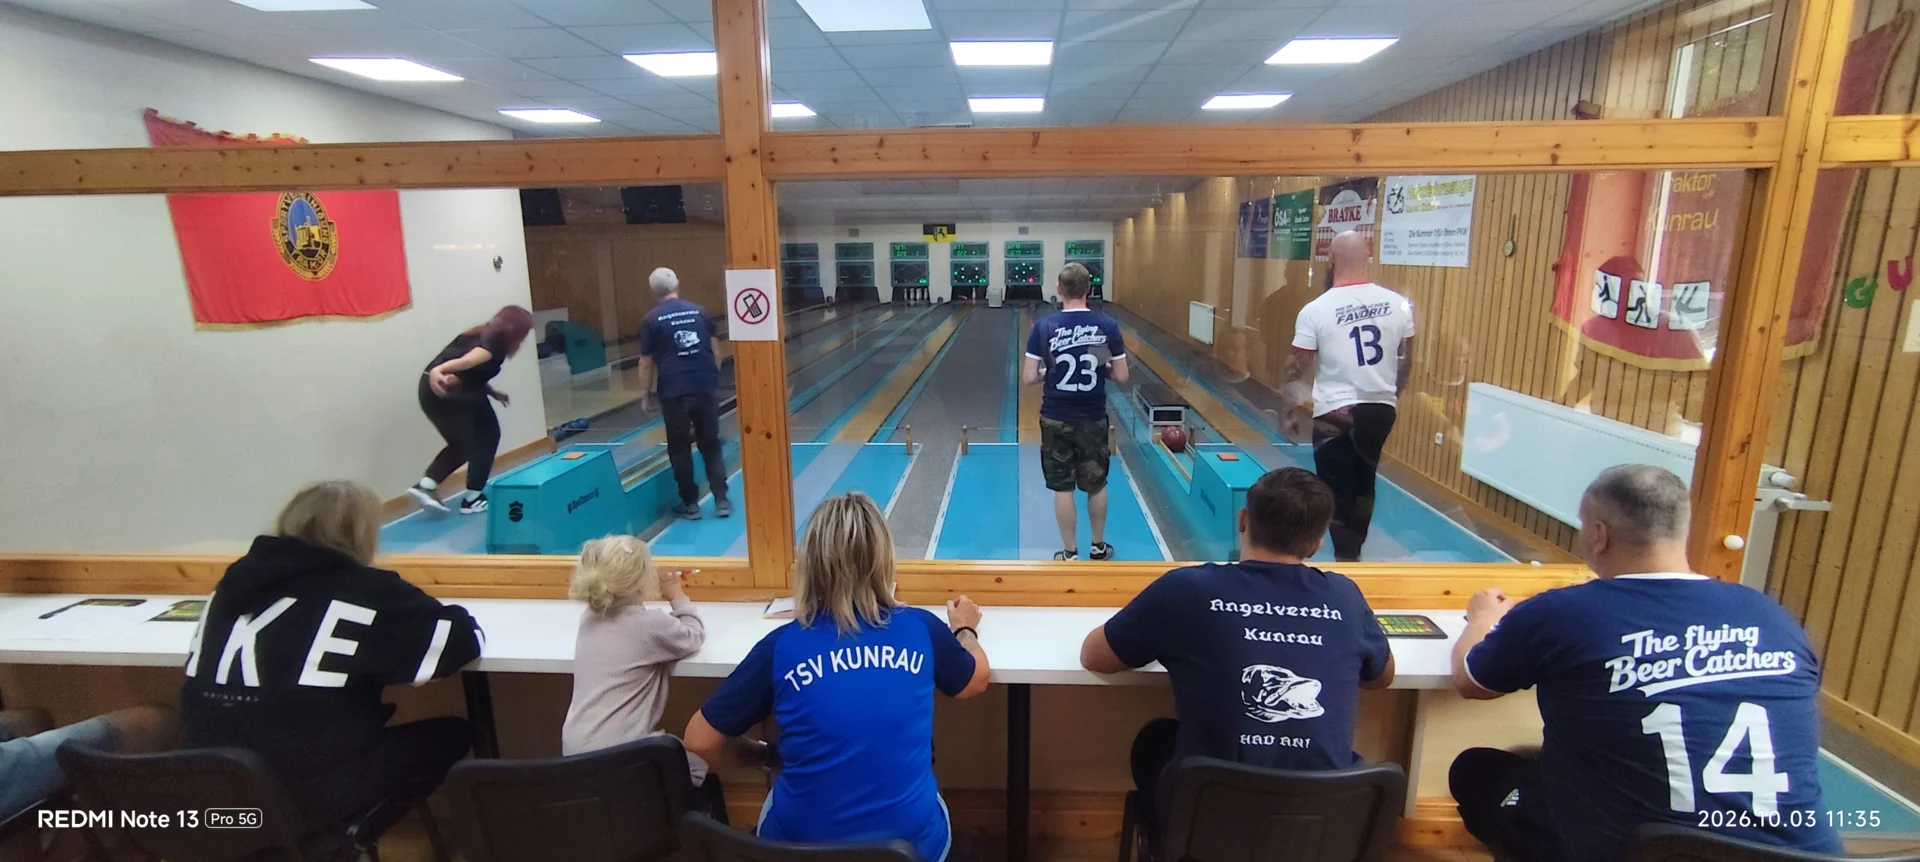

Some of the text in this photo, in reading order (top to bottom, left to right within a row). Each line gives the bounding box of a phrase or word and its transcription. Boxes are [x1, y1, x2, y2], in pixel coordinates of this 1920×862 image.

[1670, 171, 1717, 192] aktor
[1327, 205, 1362, 223] BRATKE
[1337, 306, 1391, 325] FAVORIT
[1049, 334, 1107, 352] Beer Catchers
[1054, 327, 1072, 338] The
[1349, 324, 1383, 367] 13
[1055, 353, 1099, 392] 23
[1208, 598, 1343, 622] Angelverein
[1243, 627, 1323, 647] Kunrau
[1621, 624, 1759, 659] The flying
[784, 644, 925, 692] TSV KUNRAU
[1605, 646, 1796, 694] Beer Catchers
[1279, 735, 1311, 749] AN!
[1640, 701, 1789, 818] 14
